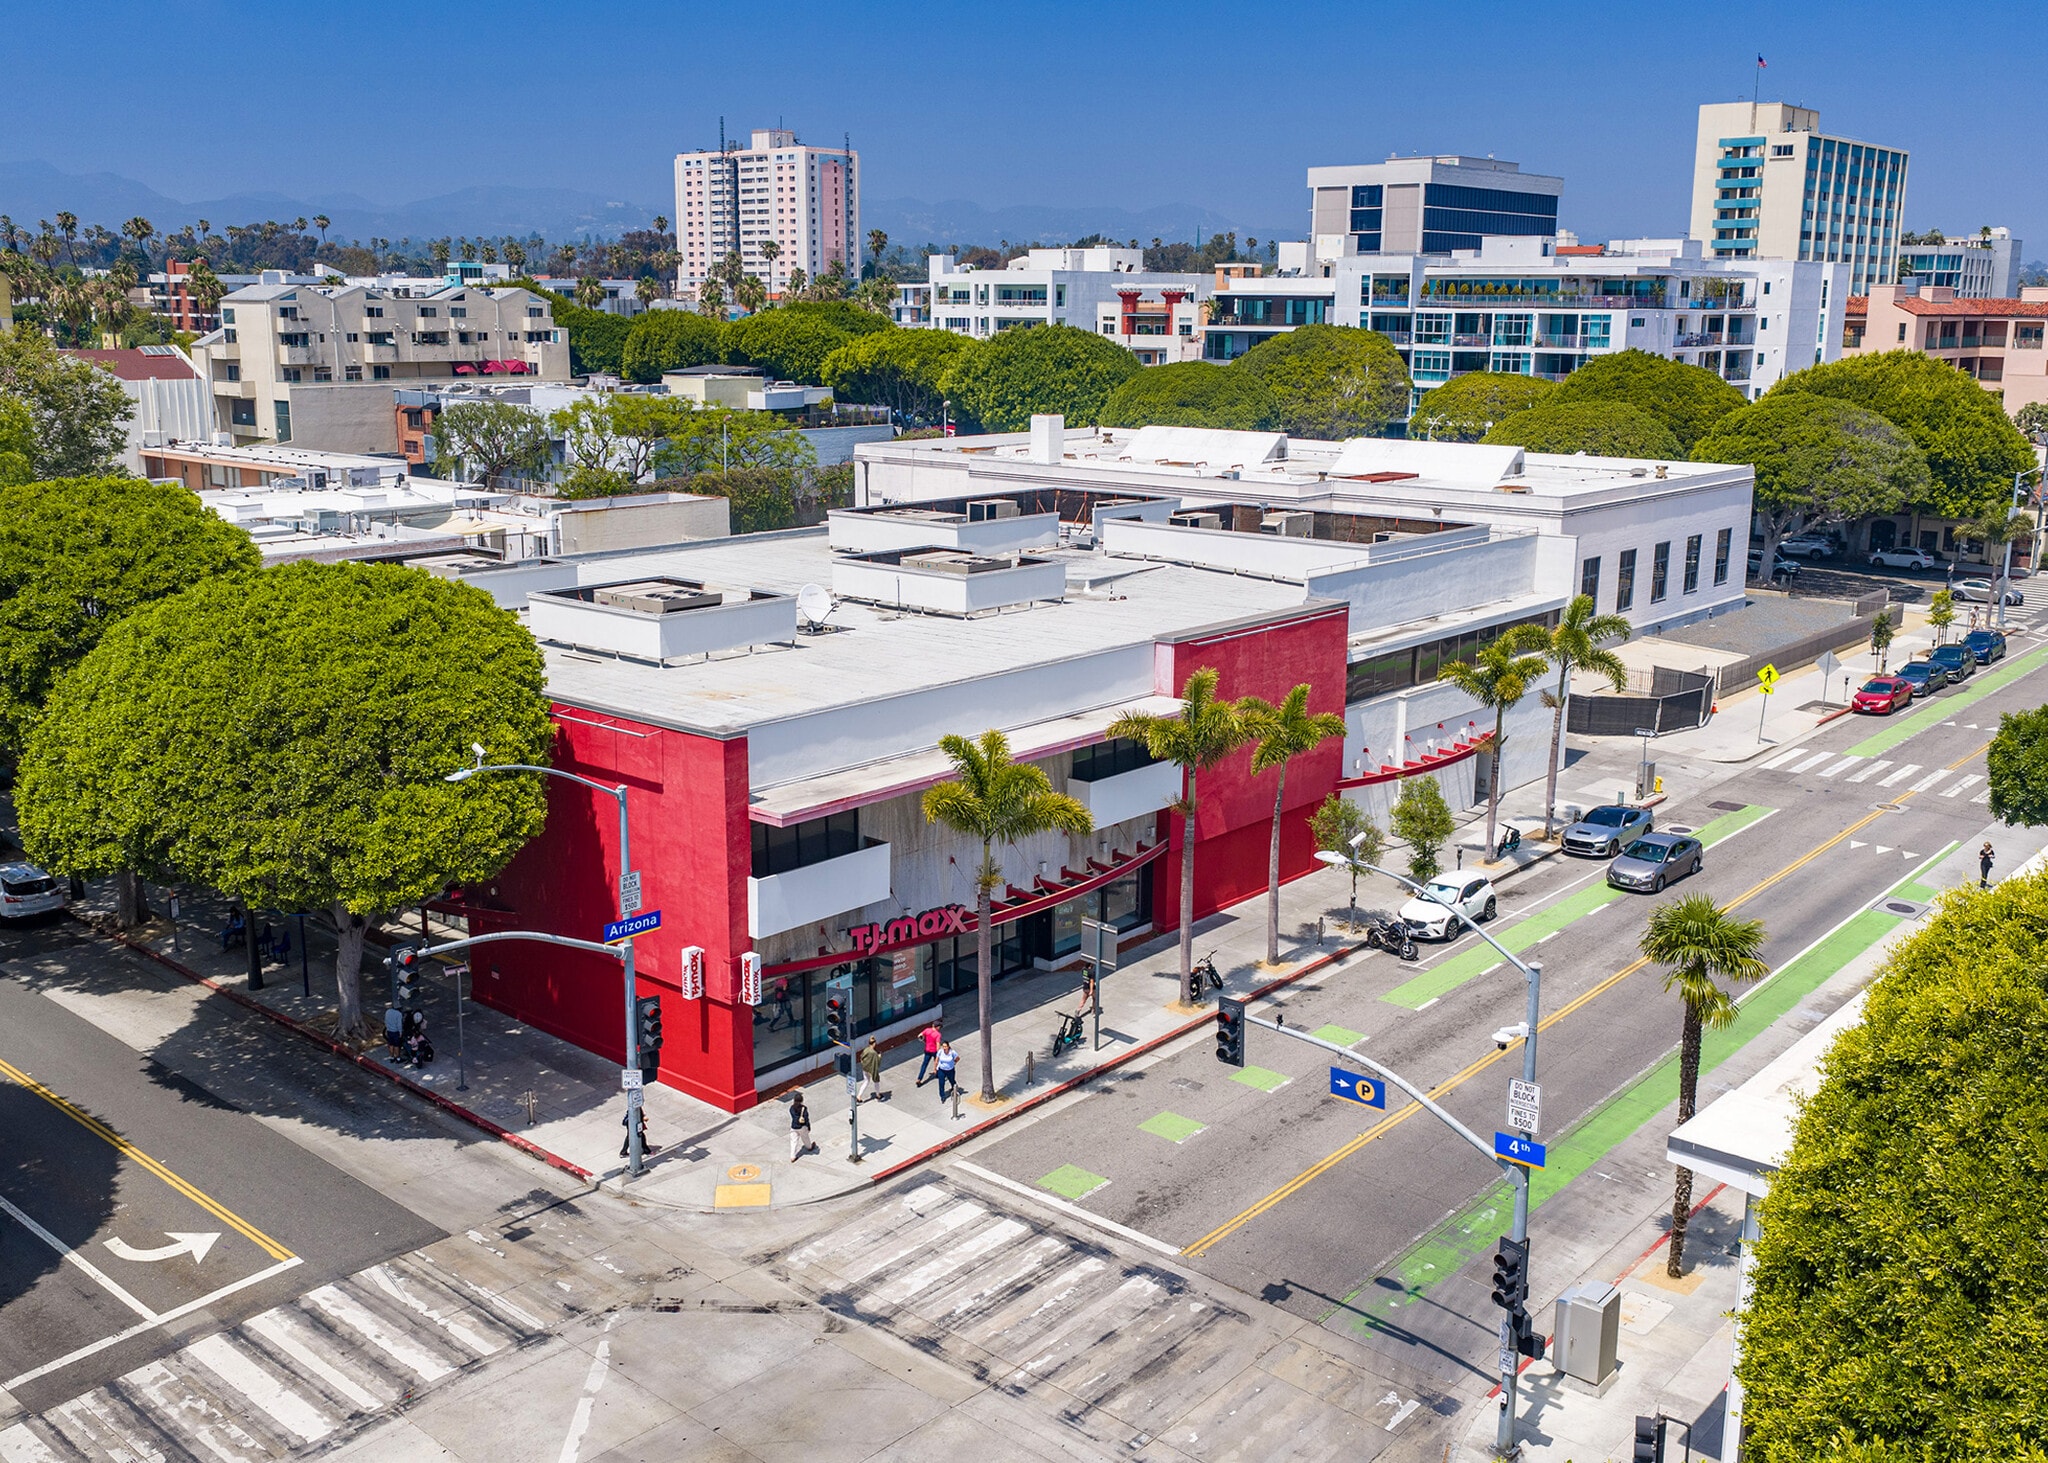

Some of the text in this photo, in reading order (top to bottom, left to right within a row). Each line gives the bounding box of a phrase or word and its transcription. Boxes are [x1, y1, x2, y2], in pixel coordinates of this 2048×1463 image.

[609, 915, 657, 937] Arizona
[1361, 1083, 1371, 1096] P
[1514, 1082, 1535, 1093] DO NOT
[1513, 1089, 1536, 1103] BLOCK
[1511, 1108, 1536, 1121] FINES TO
[1513, 1117, 1533, 1129] $500
[1509, 1140, 1531, 1154] 4th
